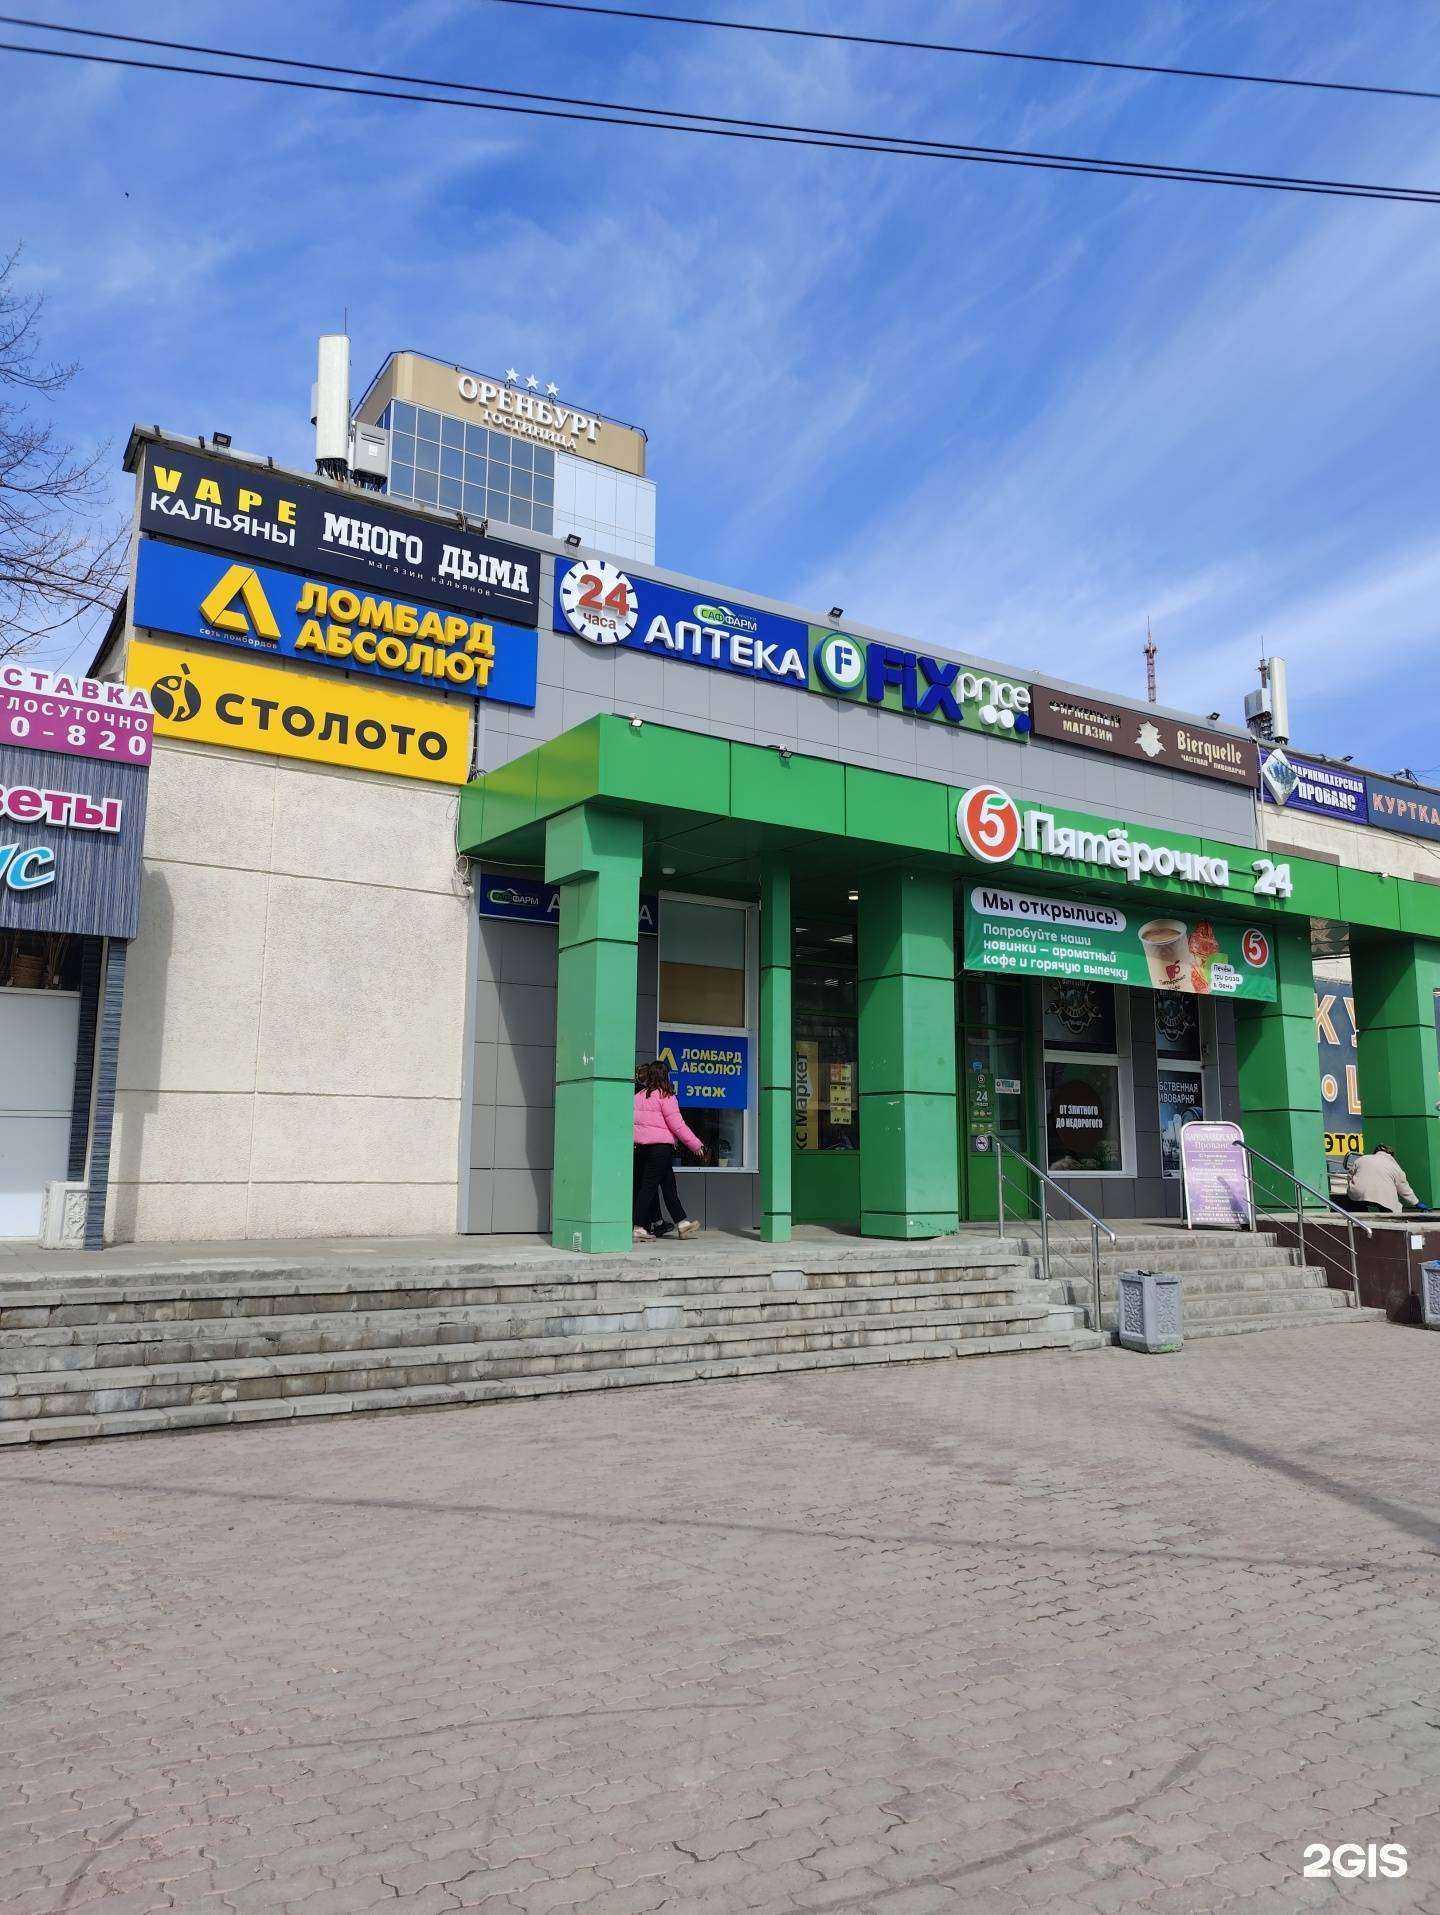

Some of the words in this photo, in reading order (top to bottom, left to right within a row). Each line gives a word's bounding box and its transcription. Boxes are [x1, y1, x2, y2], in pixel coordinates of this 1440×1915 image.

[457, 376, 602, 443] ОРЕНБУРГ
[483, 409, 577, 450] ГОСТИНИЦА
[152, 465, 297, 525] VAPE
[150, 491, 296, 547] КАЛЬЯНЫ
[322, 511, 423, 565] МНОГО
[438, 544, 530, 593] ДЫМА
[368, 559, 425, 580] магазин
[431, 575, 492, 597] кальянов
[577, 573, 631, 617] 24
[296, 581, 495, 657] ЛОМБАРД
[583, 611, 617, 630] часа
[294, 619, 495, 687] АБСОЛЮТ
[644, 614, 806, 680] АПТЕКА
[215, 692, 448, 761] СТОЛОТО
[1063, 720, 1113, 742] МАГАЗИН
[1177, 730, 1242, 765] Bierquelle
[1291, 764, 1364, 794] ПАРИКМАХЕРСКАЯ
[1298, 782, 1356, 812] ПРОВАНС
[1023, 810, 1229, 887] Пятёрочка
[1252, 859, 1293, 898] 24
[982, 891, 1014, 912] Мы
[1019, 900, 1118, 926] открылись!
[984, 923, 1058, 942] Попробуйте
[1061, 935, 1091, 946] наши
[984, 939, 1037, 954] новинки
[1053, 946, 1117, 963] ароматный
[984, 954, 1017, 968] кофе
[1020, 958, 1027, 967] и
[1030, 958, 1081, 974] горячую
[1084, 966, 1129, 981] выпечку
[681, 1048, 742, 1063] ЛОМБАРД
[681, 1062, 742, 1075] АБСОЛЮТ
[686, 1084, 727, 1098] этаж
[976, 1091, 988, 1102] 24
[1056, 1117, 1065, 1129] ДО
[1066, 1118, 1103, 1130] НЕДОРОГОГО
[1059, 1104, 1068, 1115] ОТ
[1068, 1104, 1099, 1116] ЭЛИТНОГО
